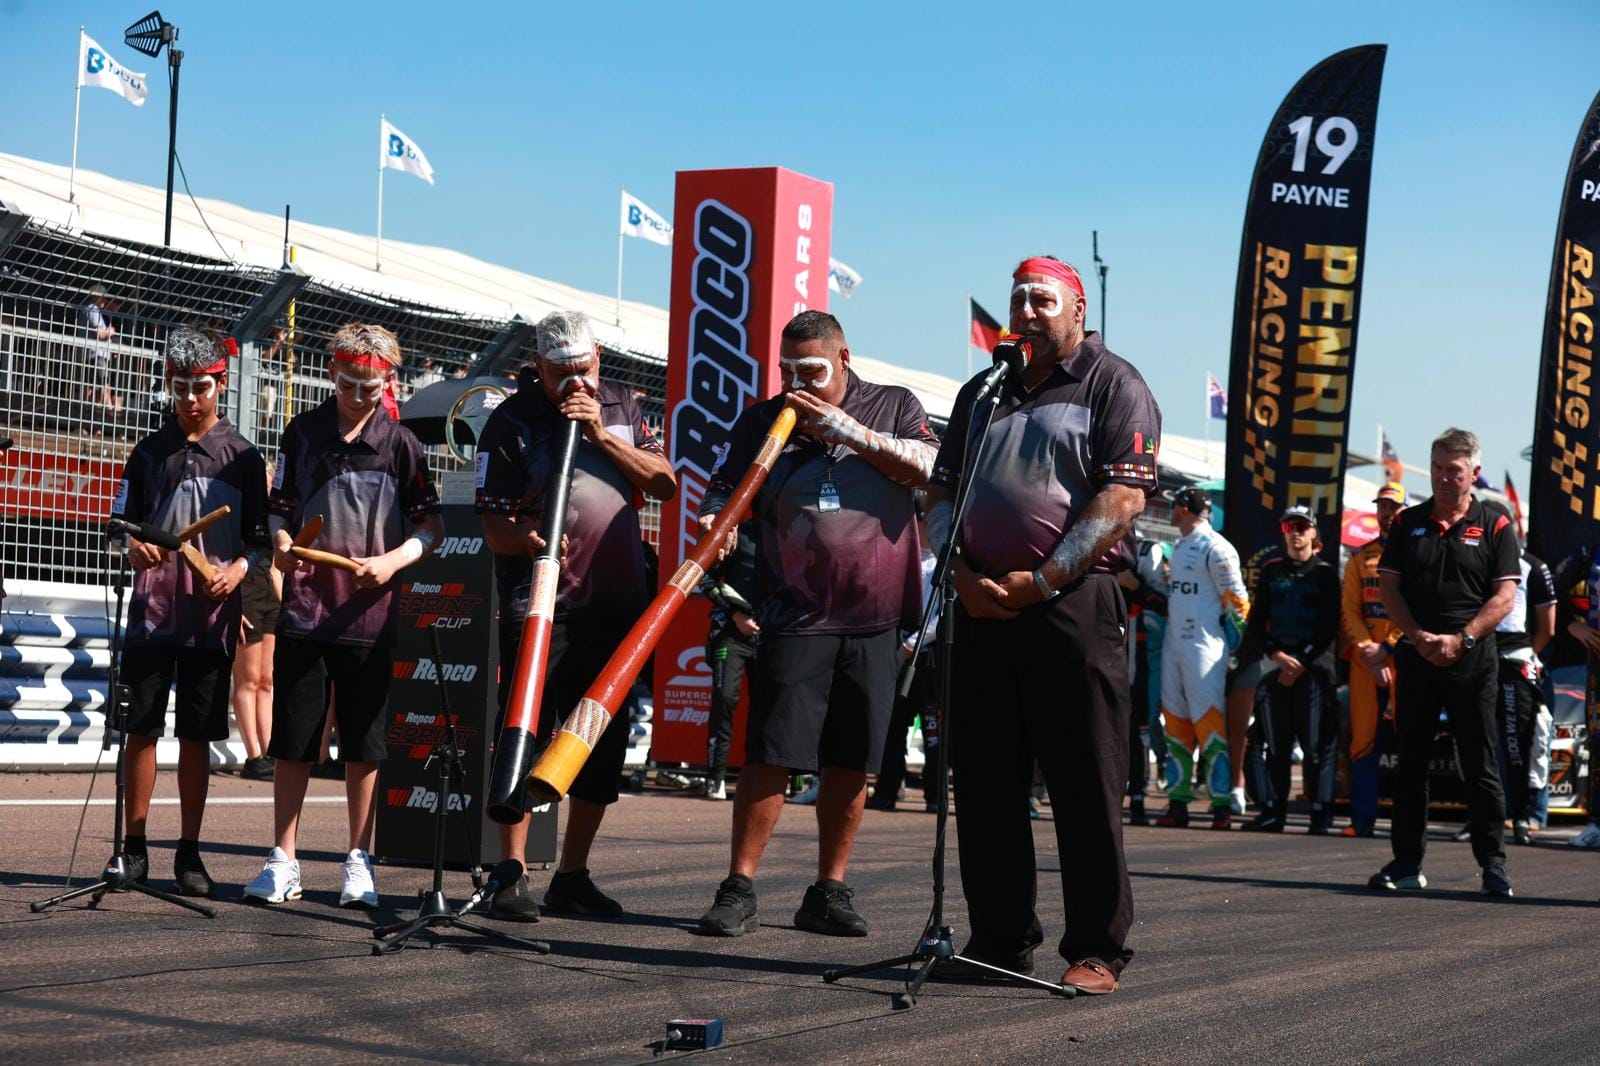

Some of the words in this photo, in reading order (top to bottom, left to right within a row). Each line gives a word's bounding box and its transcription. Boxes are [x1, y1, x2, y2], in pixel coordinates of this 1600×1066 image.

[1288, 116, 1359, 175] 19
[1271, 182, 1350, 209] PAYNE
[669, 198, 759, 478] Repco
[1253, 246, 1292, 428] RACING
[1564, 243, 1595, 430] RACING
[1287, 243, 1358, 516] PENRITE
[0, 464, 97, 495] LEY
[433, 536, 484, 559] epco
[411, 582, 442, 595] Repco
[434, 617, 472, 629] CUP
[411, 658, 478, 685] Repco
[404, 712, 436, 725] Repco
